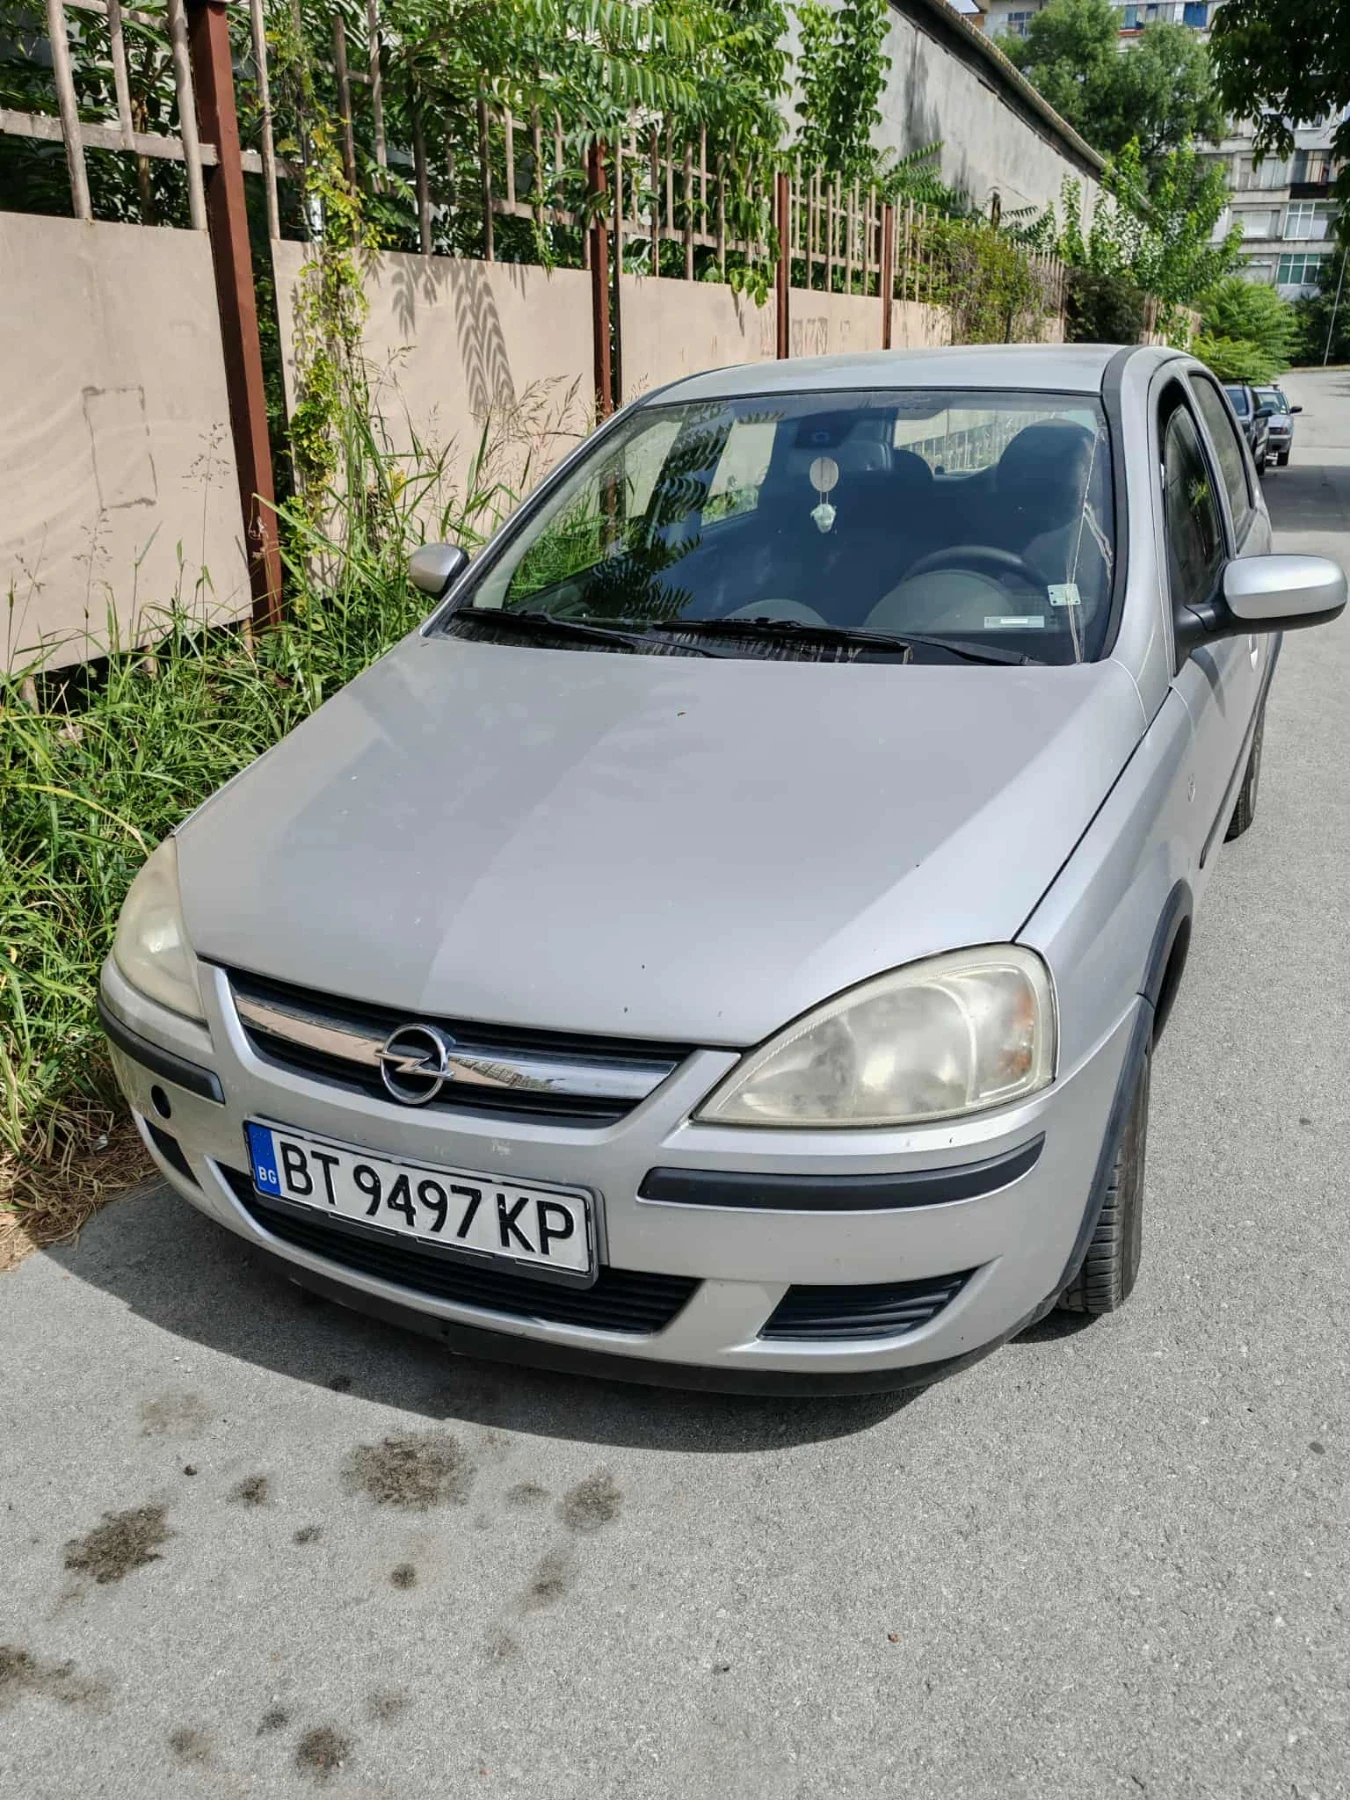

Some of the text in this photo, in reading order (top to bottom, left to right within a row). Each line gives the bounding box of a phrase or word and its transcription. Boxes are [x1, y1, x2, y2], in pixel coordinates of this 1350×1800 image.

[257, 1166, 277, 1185] BG
[279, 1141, 575, 1255] BT 9497 KP
